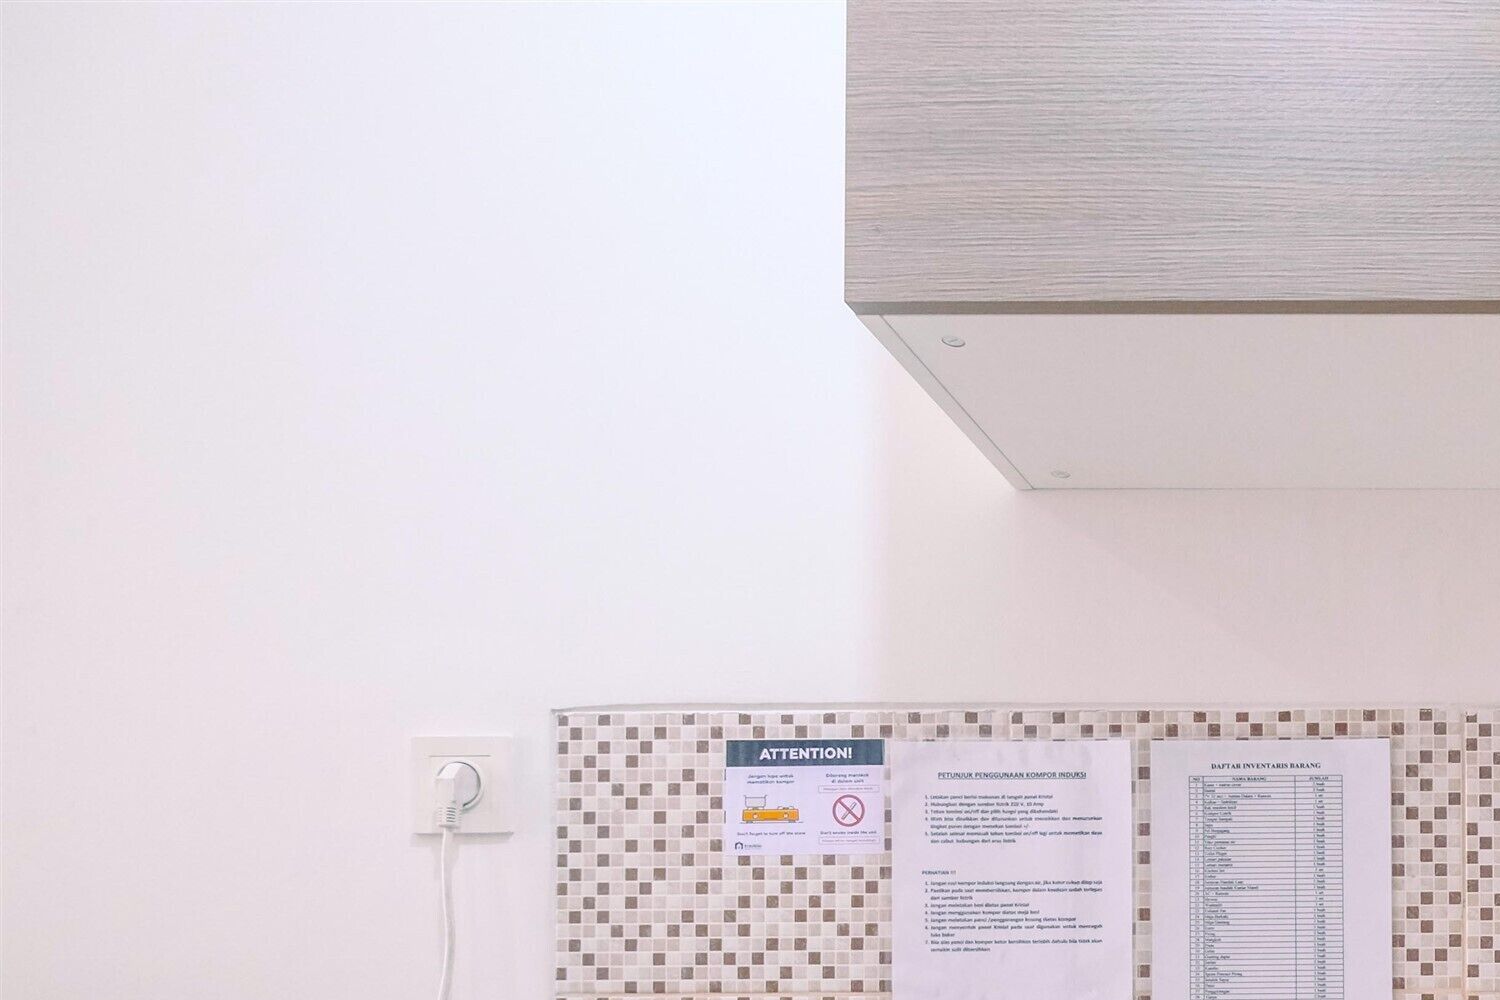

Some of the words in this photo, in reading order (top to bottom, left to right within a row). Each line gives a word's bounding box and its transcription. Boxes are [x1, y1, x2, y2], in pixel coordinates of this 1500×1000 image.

[759, 746, 853, 760] ATTENTION!
[938, 772, 973, 780] PETUNJUK
[975, 772, 1024, 780] PENGGUNAAN
